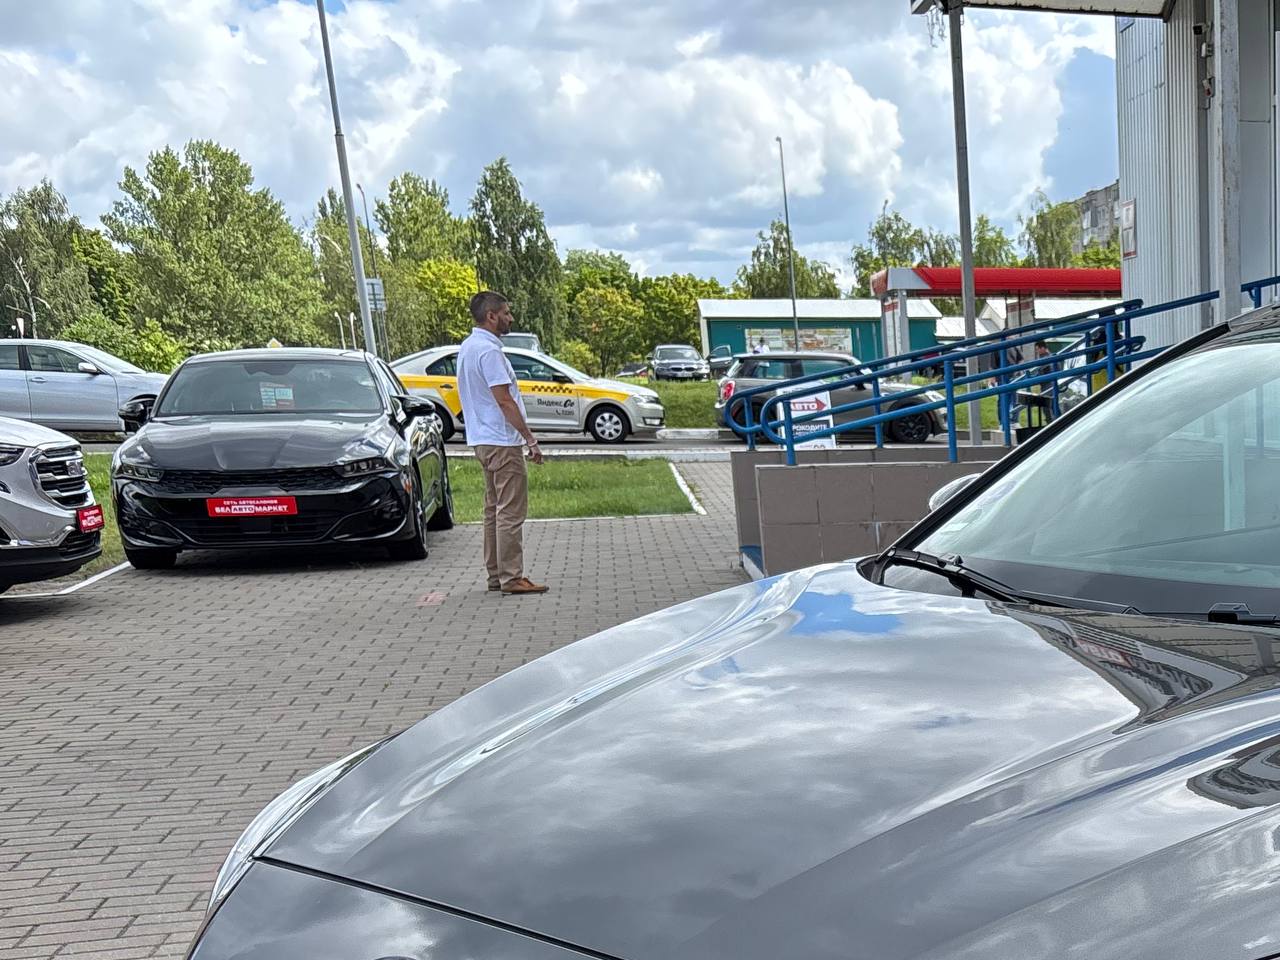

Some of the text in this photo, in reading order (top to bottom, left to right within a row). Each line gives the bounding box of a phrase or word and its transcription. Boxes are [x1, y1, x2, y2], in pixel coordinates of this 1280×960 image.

[537, 398, 562, 408] Яндекс
[792, 424, 828, 433] РОХОДИТЕ
[232, 505, 254, 513] АВТО
